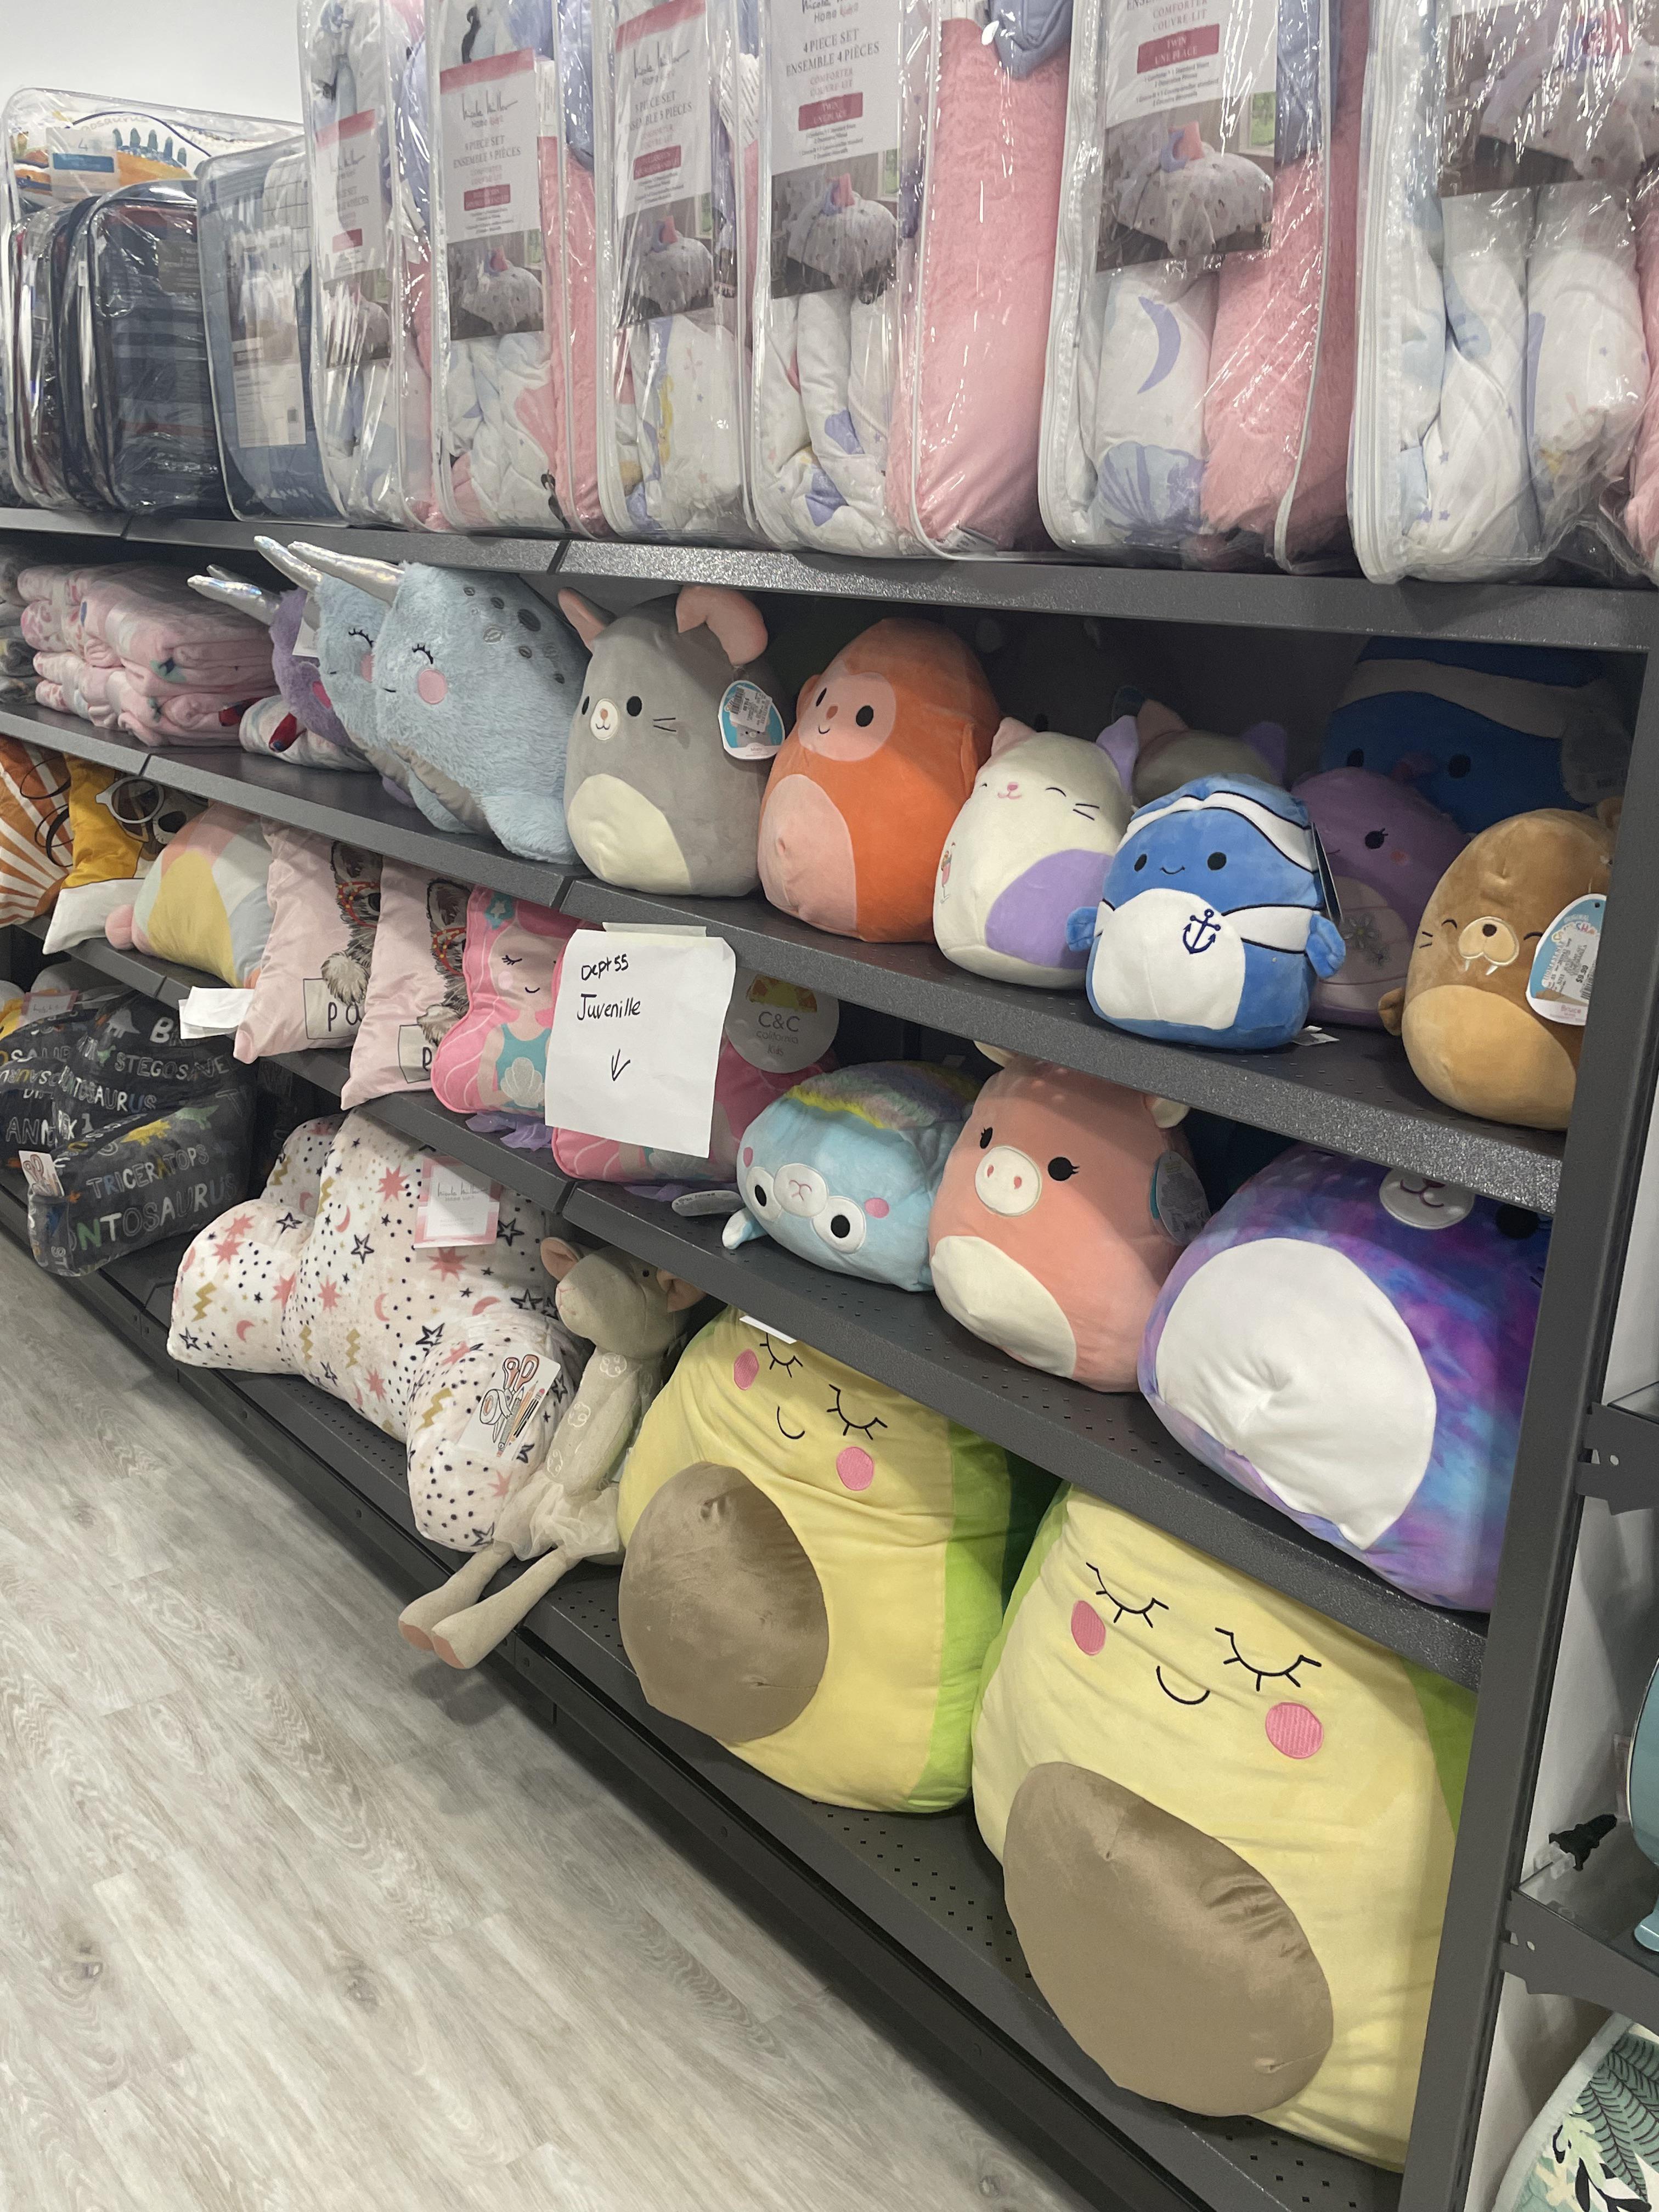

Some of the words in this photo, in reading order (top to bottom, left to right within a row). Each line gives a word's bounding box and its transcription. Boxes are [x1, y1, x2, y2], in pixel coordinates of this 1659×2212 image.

[810, 33, 838, 53] PIECE
[840, 28, 859, 45] SET
[786, 53, 834, 77] ENSEMBLE
[640, 96, 660, 113] PICE
[582, 957, 612, 981] Dept
[614, 953, 629, 972] 55
[577, 993, 641, 1021] Juvenille
[758, 1011, 800, 1032] C&C
[86, 1143, 210, 1199] TRICERATOPS
